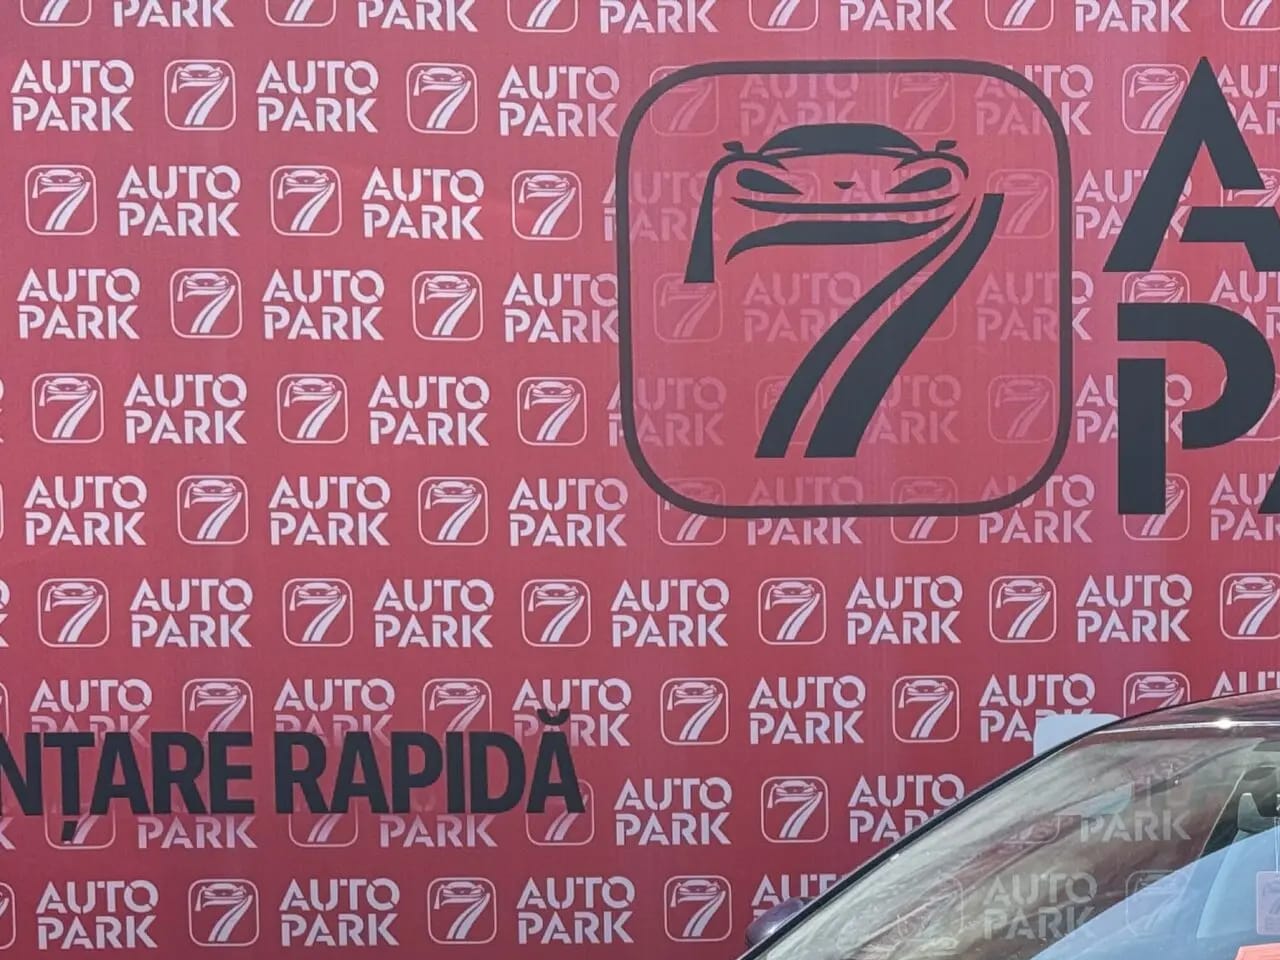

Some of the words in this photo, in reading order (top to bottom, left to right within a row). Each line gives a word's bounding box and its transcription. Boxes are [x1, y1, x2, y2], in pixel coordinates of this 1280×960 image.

[114, 0, 234, 28] PARK
[358, 0, 478, 32] PARK
[600, 0, 719, 34] PARK
[840, 0, 957, 32] PARK
[1075, 0, 1192, 33] PARK
[10, 59, 134, 94] AUTO
[256, 59, 379, 96] AUTO
[498, 65, 619, 101] AUTO
[12, 96, 134, 132] PARK
[258, 96, 378, 133] PARK
[499, 102, 617, 137] PARK
[117, 165, 241, 200] AUTO
[361, 166, 484, 203] AUTO
[119, 201, 240, 237] PARK
[363, 203, 484, 240] PARK
[16, 268, 140, 303] AUTO
[262, 269, 385, 304] AUTO
[504, 273, 620, 307] AUTO
[19, 304, 140, 340] PARK
[264, 305, 384, 341] PARK
[505, 309, 620, 343] PARK
[123, 373, 247, 408] AUTO
[368, 375, 490, 411] AUTO
[125, 409, 247, 444] PARK
[370, 411, 489, 447] PARK
[23, 475, 147, 510] AUTO
[268, 475, 391, 510] AUTO
[509, 477, 629, 512] AUTO
[25, 511, 147, 546] PARK
[270, 511, 390, 546] PARK
[510, 512, 627, 547] PARK
[979, 510, 1093, 544] PARK
[129, 578, 253, 612] AUTO
[373, 579, 494, 612] AUTO
[610, 578, 729, 612] AUTO
[845, 575, 963, 610] AUTO
[1076, 574, 1192, 608] AUTO
[131, 613, 254, 648] PARK
[375, 614, 493, 648] PARK
[612, 613, 728, 647] PARK
[847, 610, 961, 645] PARK
[1077, 608, 1191, 643] PARK
[30, 678, 152, 713] AUTO
[274, 678, 395, 713] AUTO
[512, 678, 632, 711] AUTO
[748, 675, 866, 710] AUTO
[980, 673, 1097, 706] AUTO
[750, 710, 864, 744] PARK
[275, 708, 585, 815] RAPIDĂ
[613, 777, 732, 811] AUTO
[848, 774, 965, 808] AUTO
[137, 815, 258, 849] PARK
[379, 815, 498, 848] PARK
[616, 812, 731, 846] PARK
[36, 880, 159, 915] AUTO
[279, 878, 400, 912] AUTO
[516, 876, 635, 909] AUTO
[37, 915, 158, 950] PARK
[281, 913, 400, 947] PARK
[518, 911, 634, 944] PARK
